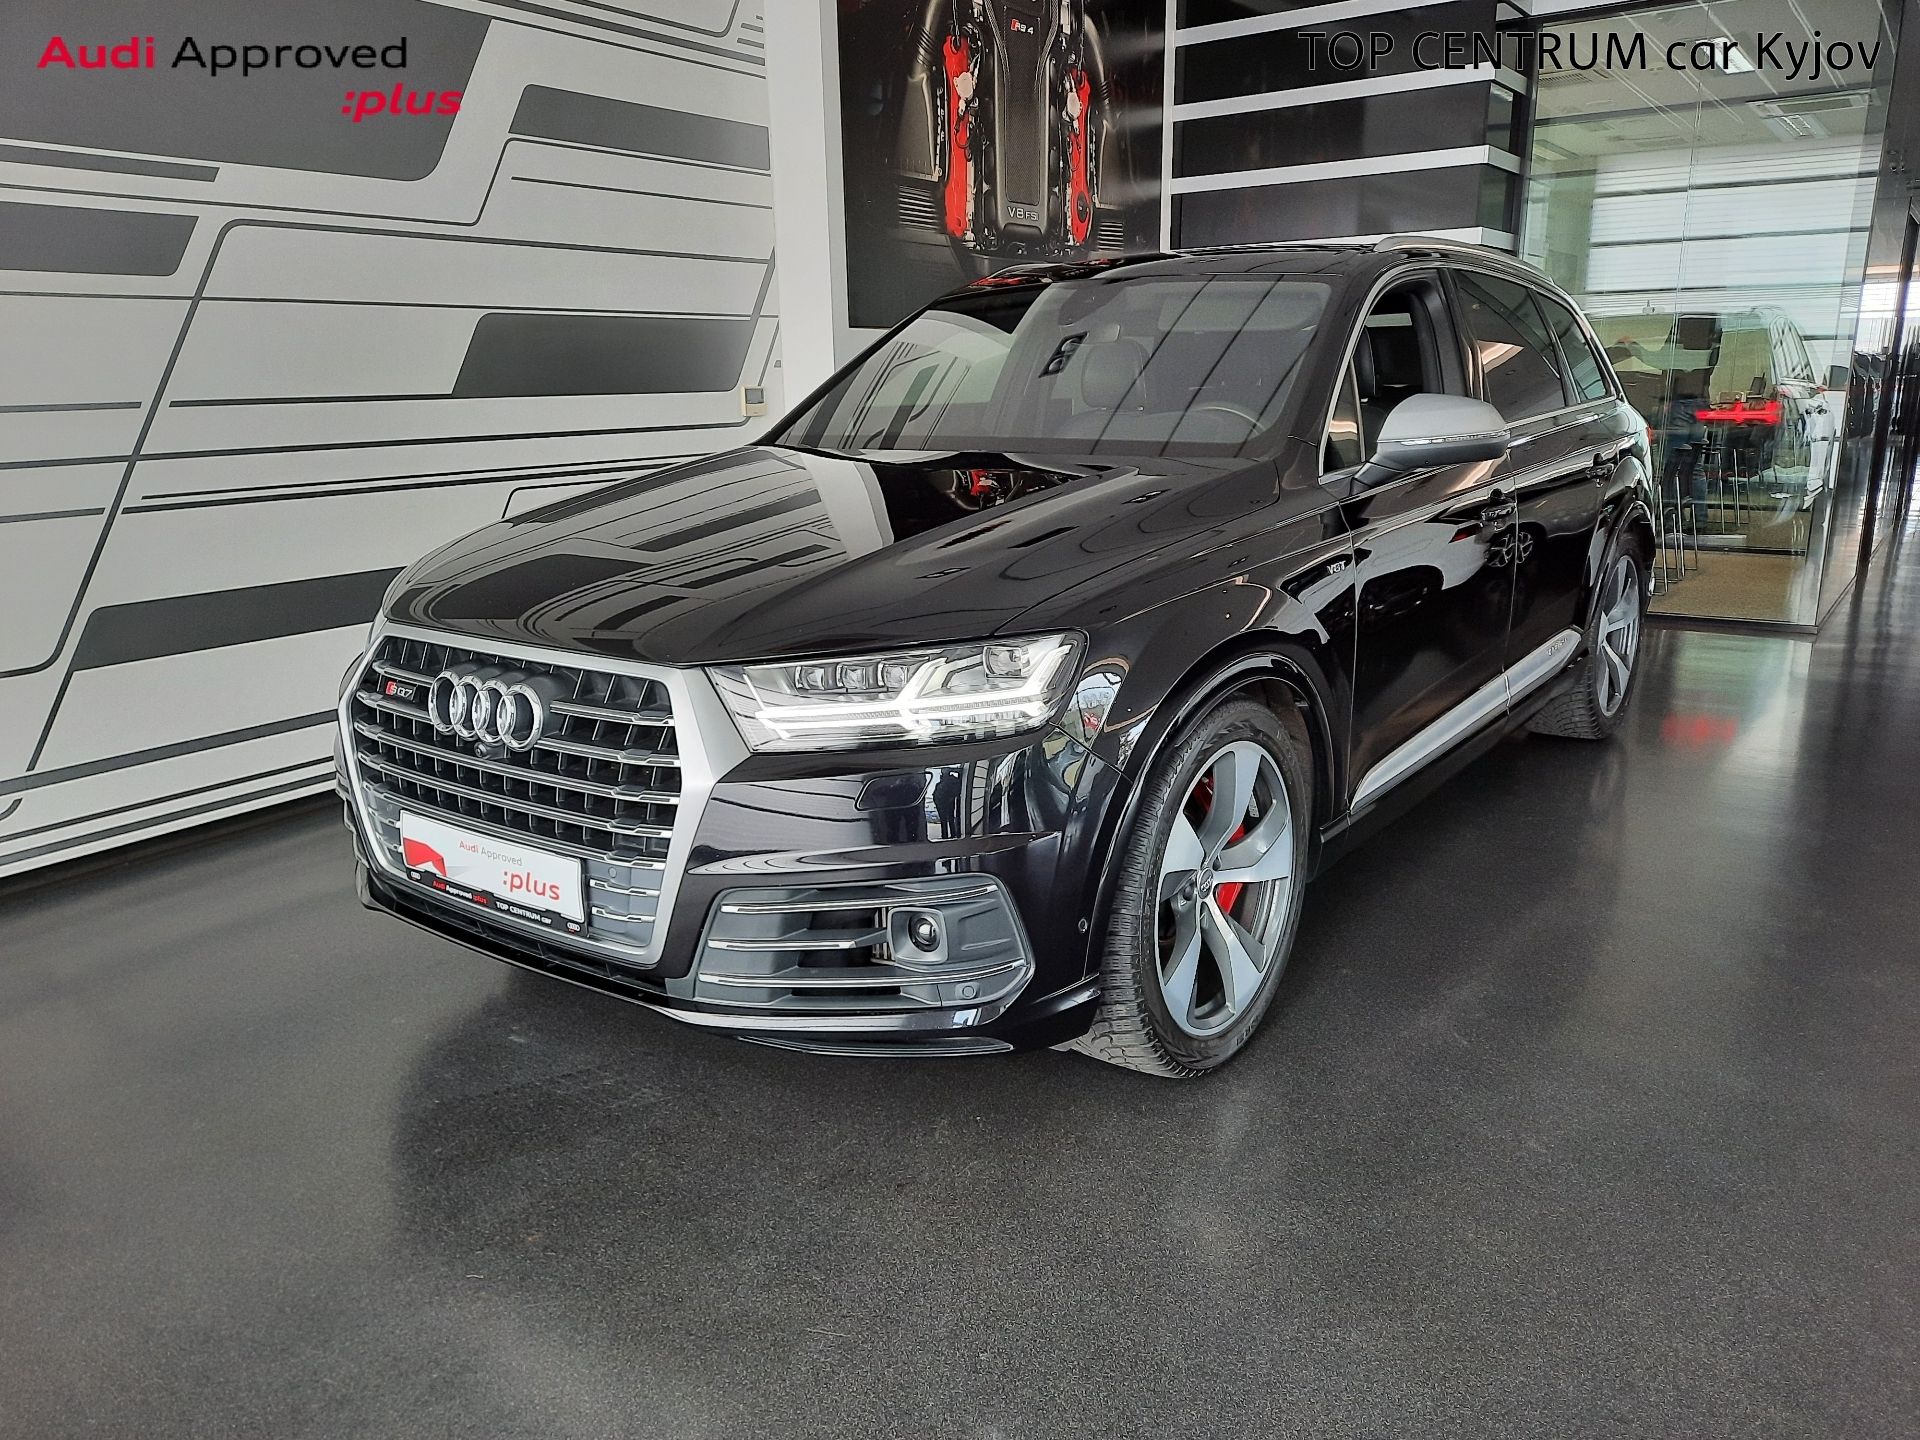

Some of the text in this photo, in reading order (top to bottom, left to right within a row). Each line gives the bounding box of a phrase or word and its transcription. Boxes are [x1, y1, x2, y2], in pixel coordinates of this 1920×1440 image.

[459, 840, 523, 866] Audi Approved
[502, 871, 561, 901] :plus
[495, 901, 510, 911] TOP
[509, 905, 541, 921] CENTRUM
